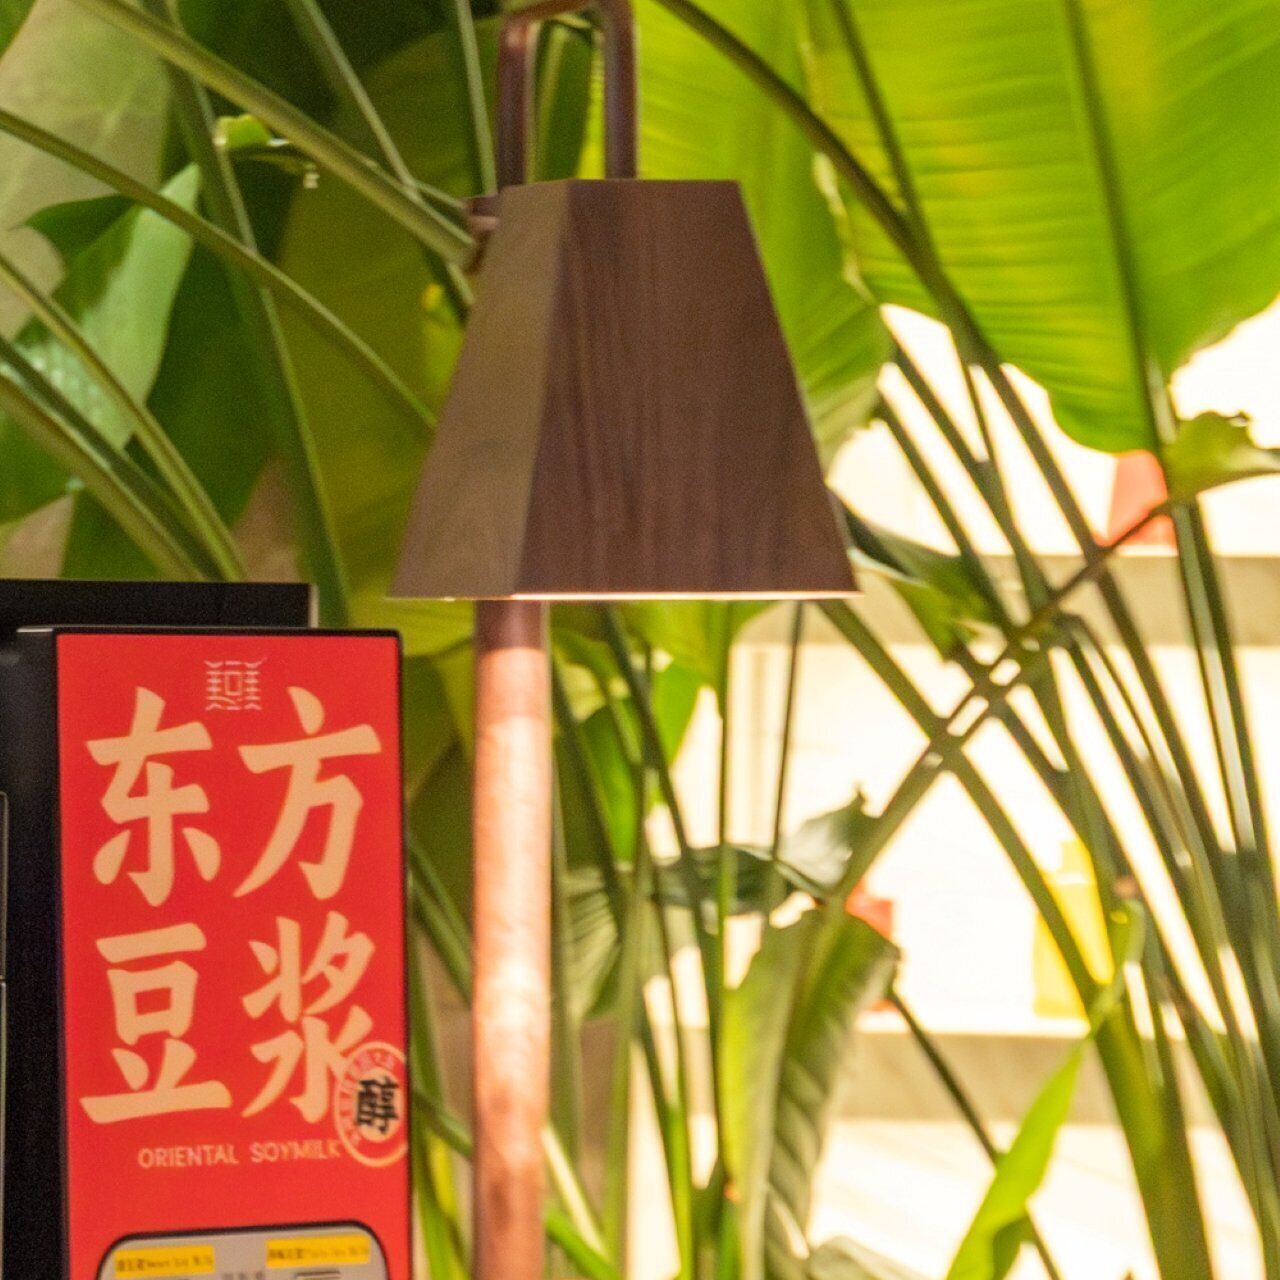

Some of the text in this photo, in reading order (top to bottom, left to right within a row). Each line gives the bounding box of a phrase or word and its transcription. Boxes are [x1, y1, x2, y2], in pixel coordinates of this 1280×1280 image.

[85, 686, 383, 907] 东方
[78, 911, 376, 1124] 豆浆
[137, 1138, 341, 1169] ORIENTAL SOYMILK
